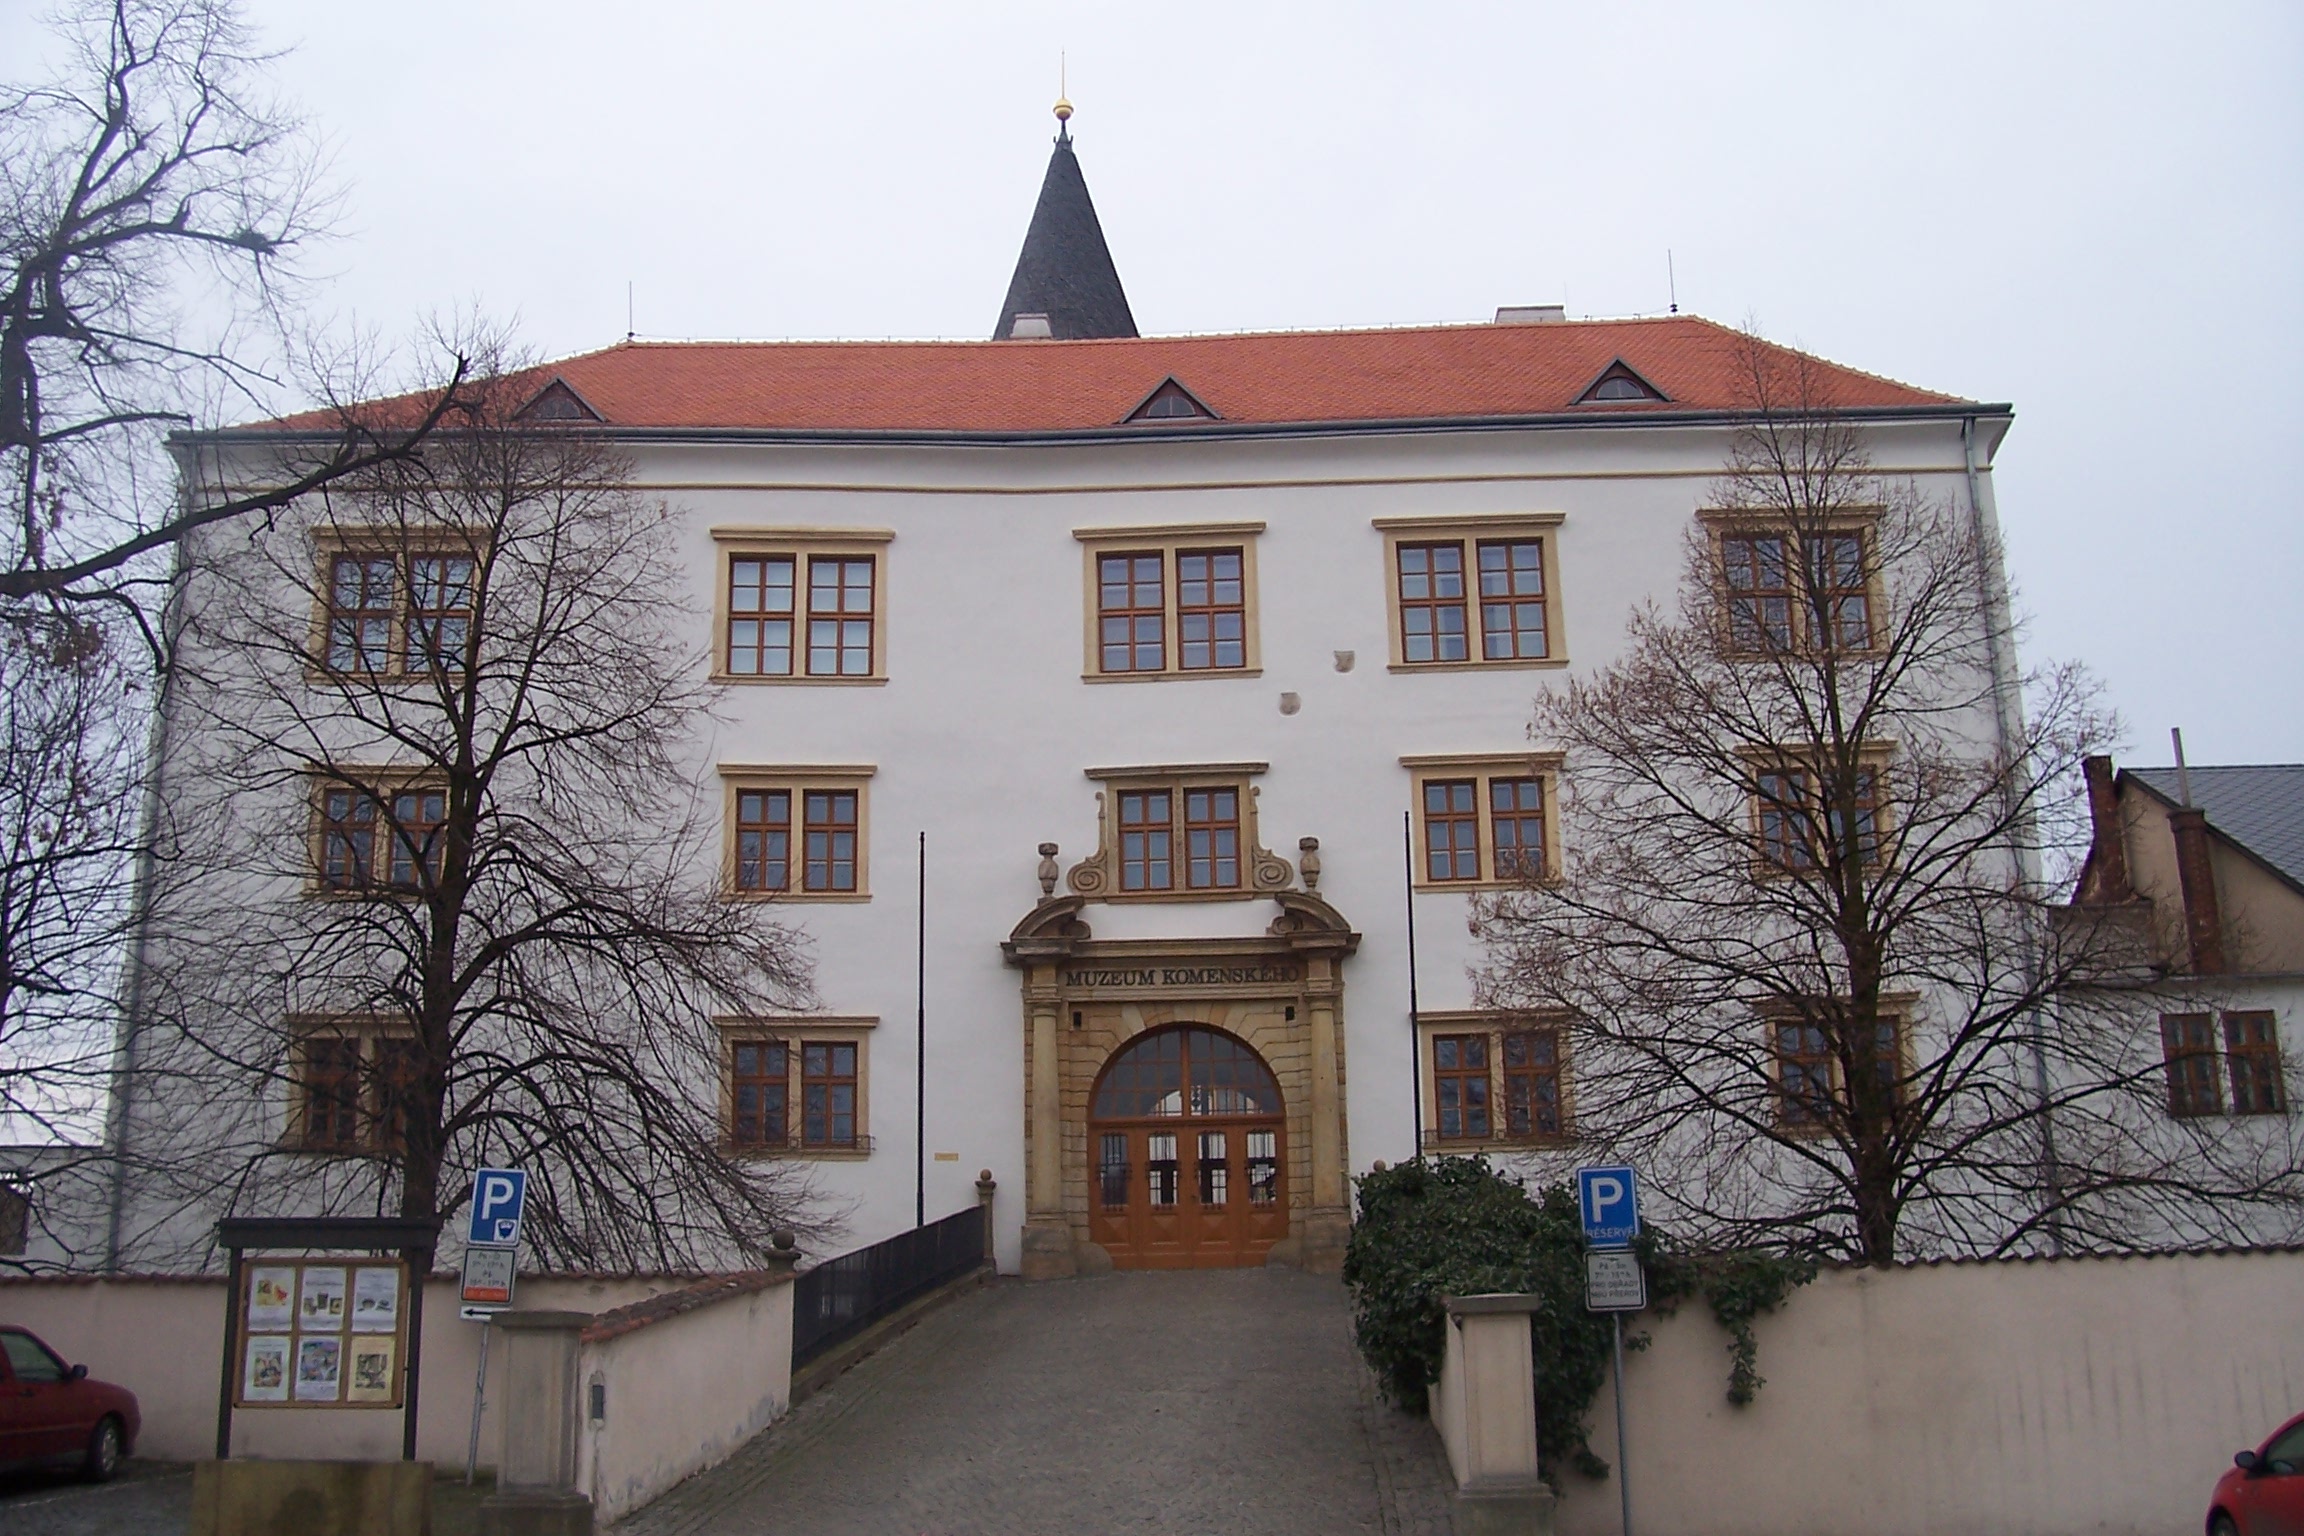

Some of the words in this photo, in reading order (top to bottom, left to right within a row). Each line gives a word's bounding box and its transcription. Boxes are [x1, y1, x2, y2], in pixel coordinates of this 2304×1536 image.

[1066, 969, 1156, 986] MUZEUM
[1162, 964, 1299, 984] KOMENSKÉHO
[482, 1177, 514, 1220] P
[1591, 1177, 1623, 1223] P
